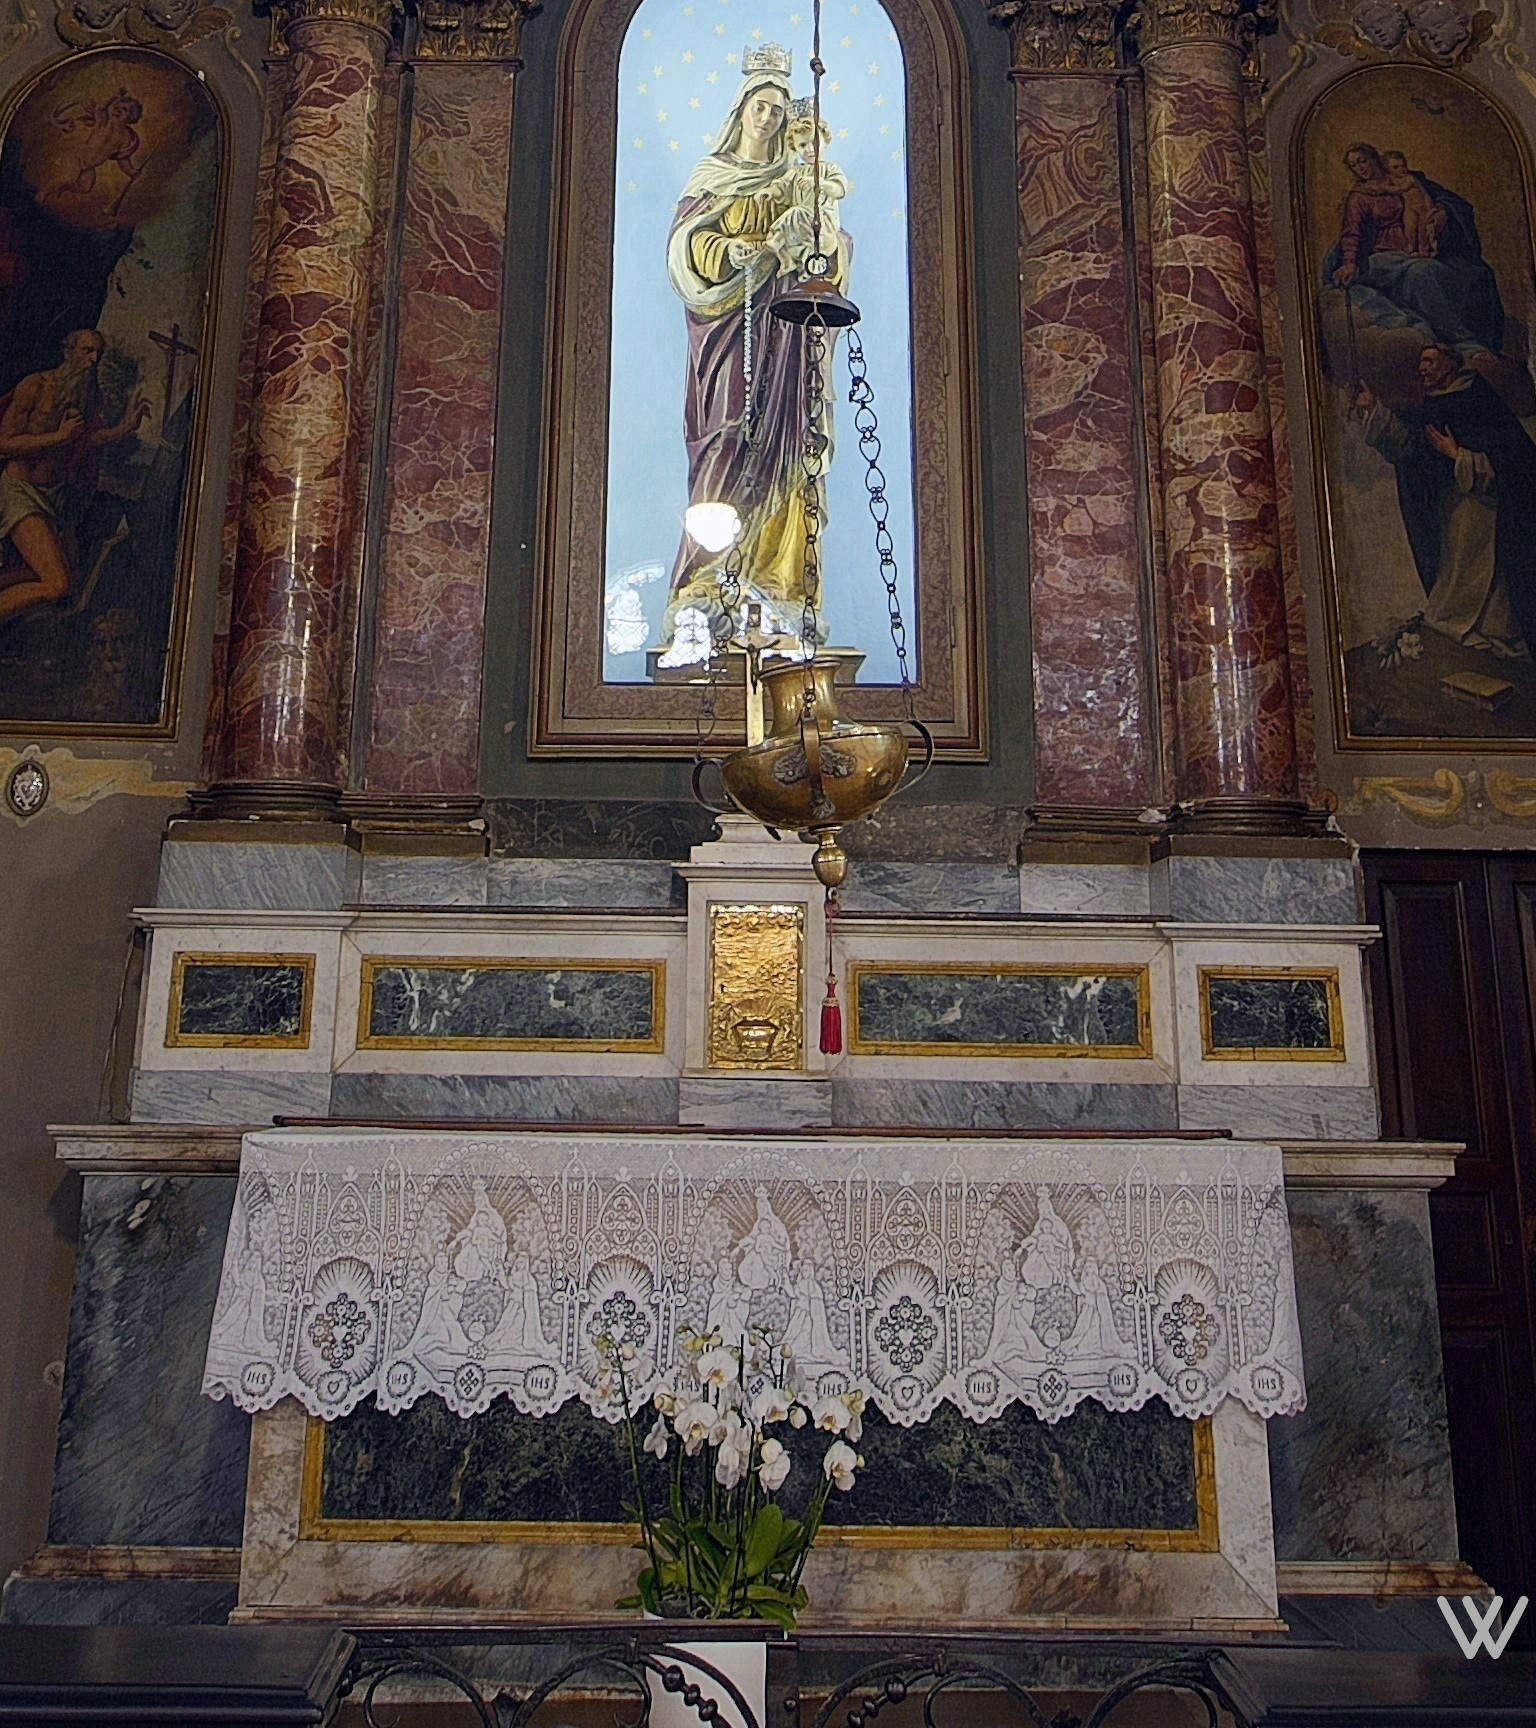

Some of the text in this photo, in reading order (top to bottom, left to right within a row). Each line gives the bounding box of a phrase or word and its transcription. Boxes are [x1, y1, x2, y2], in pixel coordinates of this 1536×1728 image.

[246, 1371, 266, 1385] IHS
[391, 1373, 409, 1387] IHS
[530, 1376, 550, 1389] IHS
[1113, 1373, 1132, 1386] IHS
[1257, 1377, 1277, 1390] IHS
[822, 1382, 843, 1396] IHS
[972, 1381, 992, 1394] IHS
